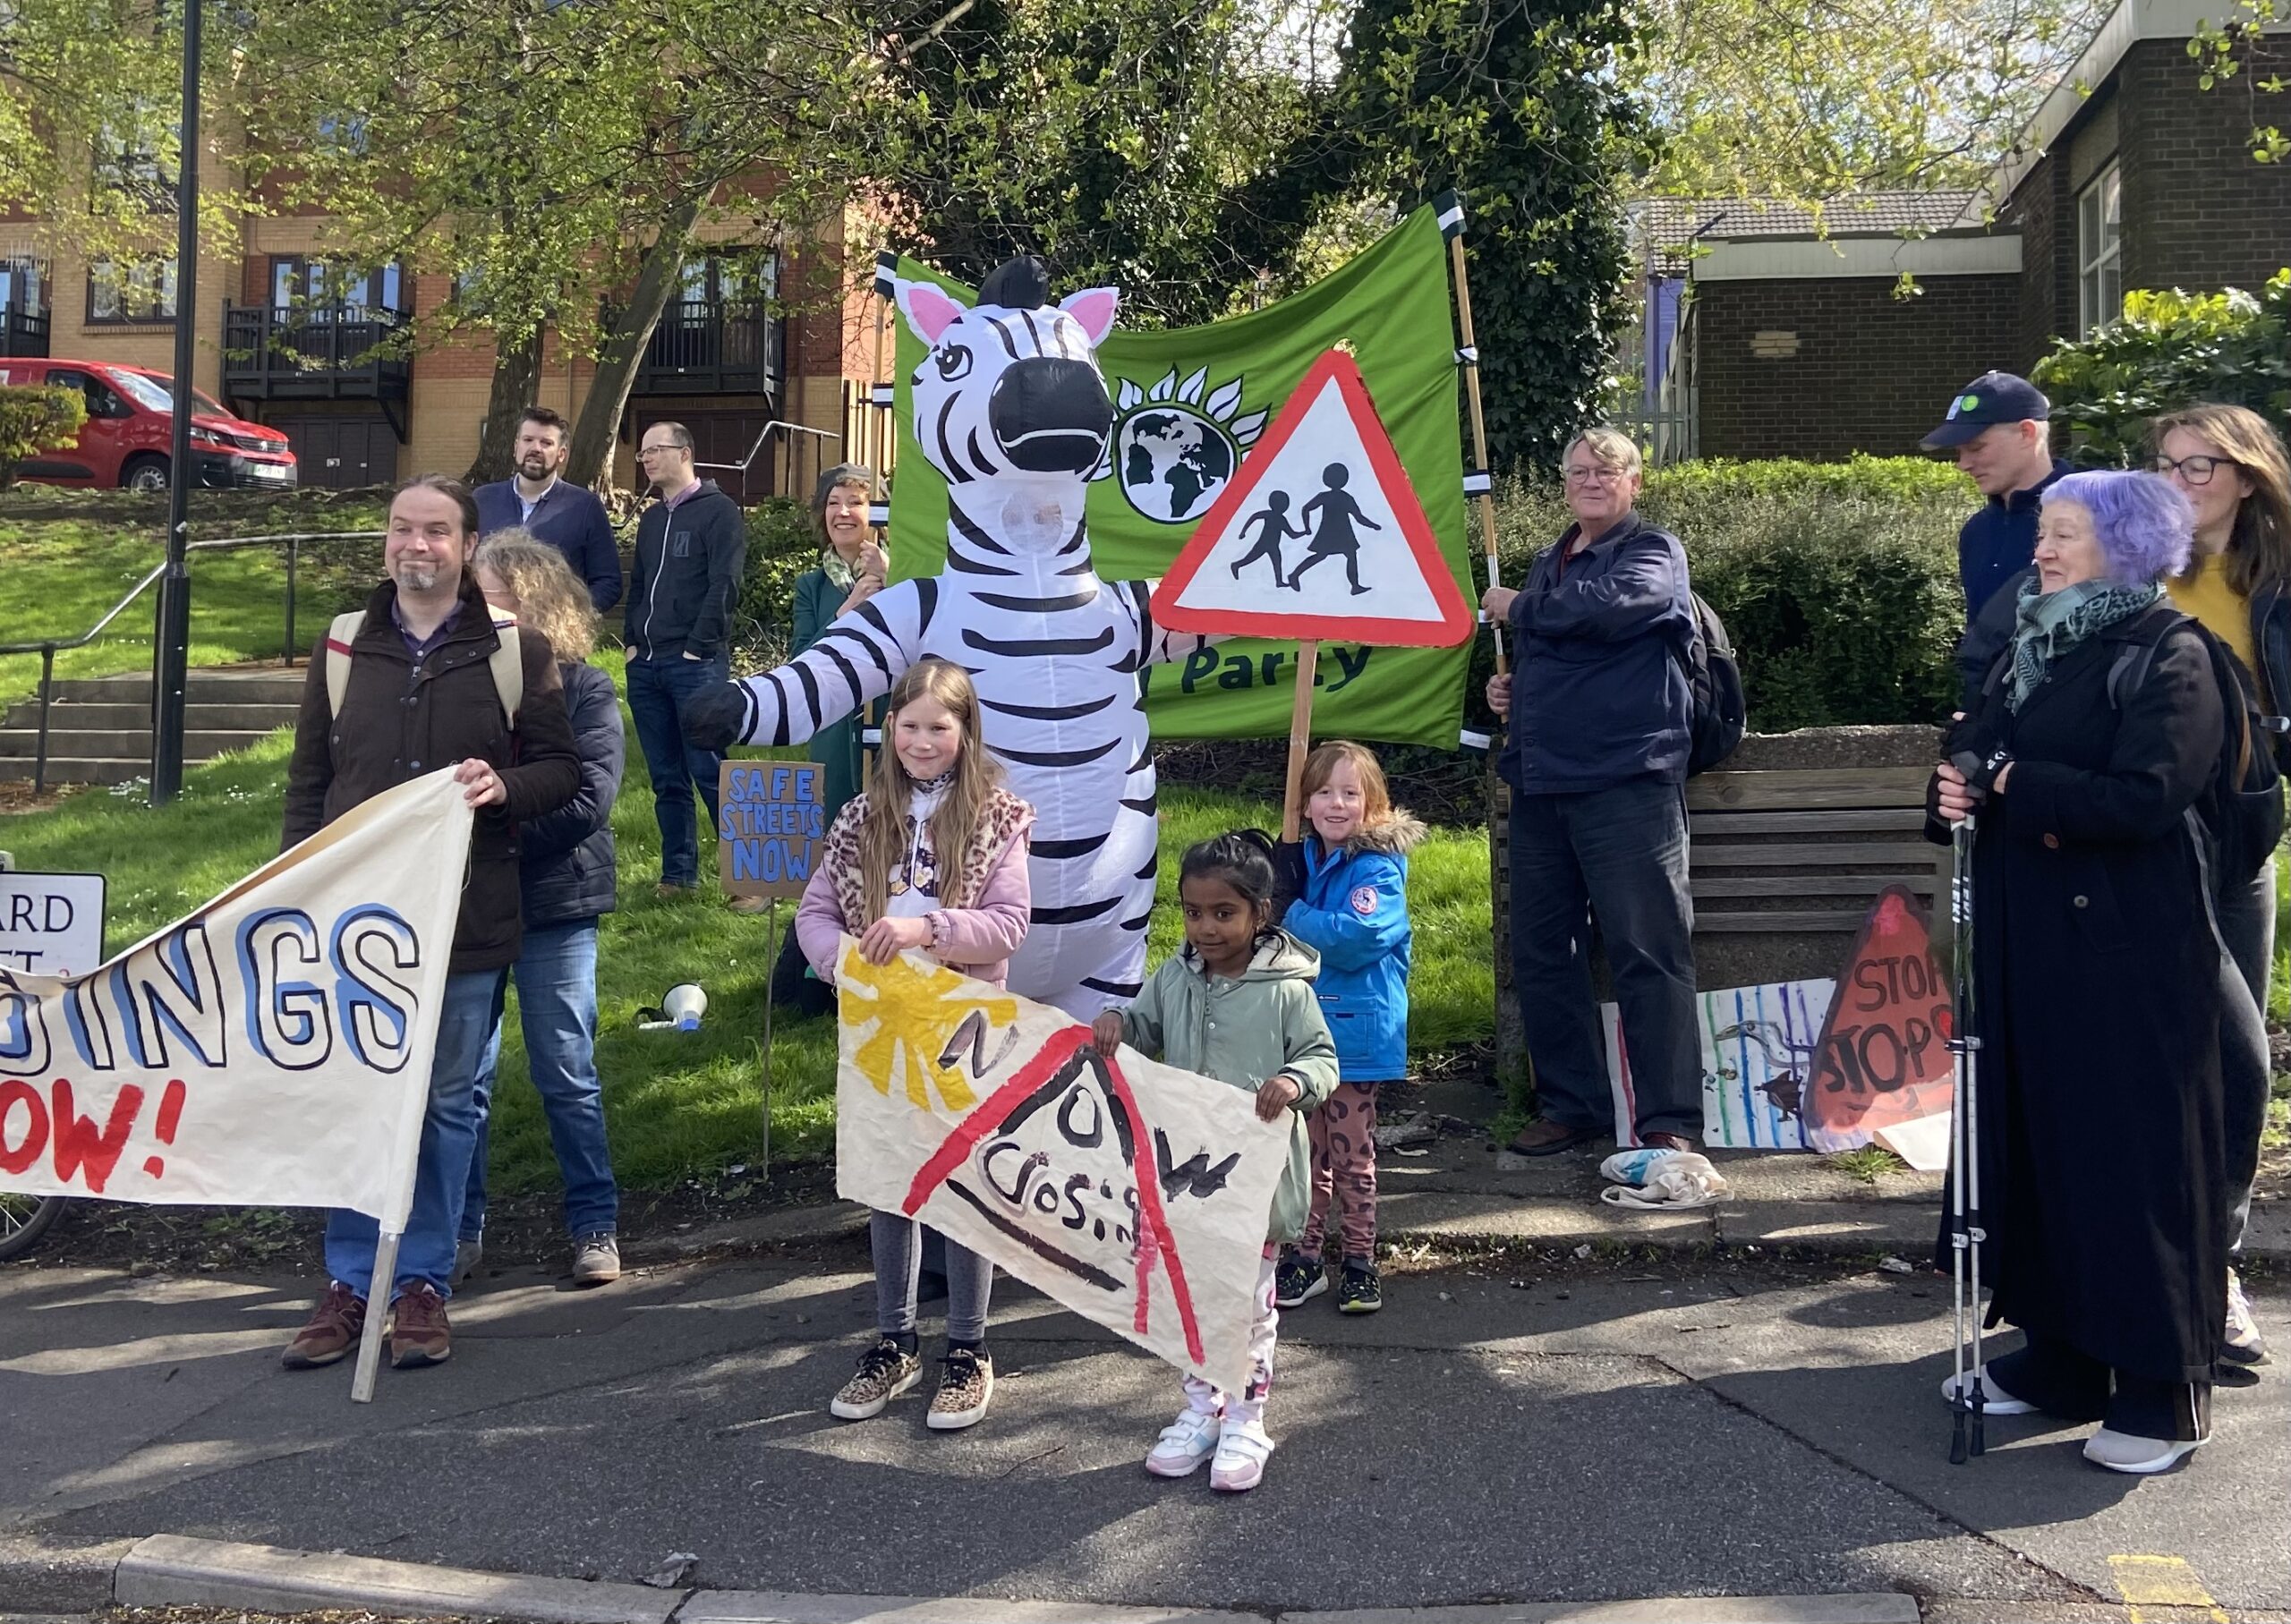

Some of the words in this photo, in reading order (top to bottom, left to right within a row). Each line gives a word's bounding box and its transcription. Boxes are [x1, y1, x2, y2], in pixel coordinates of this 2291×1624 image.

[728, 768, 815, 803] SAFE
[720, 802, 823, 841] STREETS
[731, 838, 813, 882] NOW
[0, 894, 73, 932] RD
